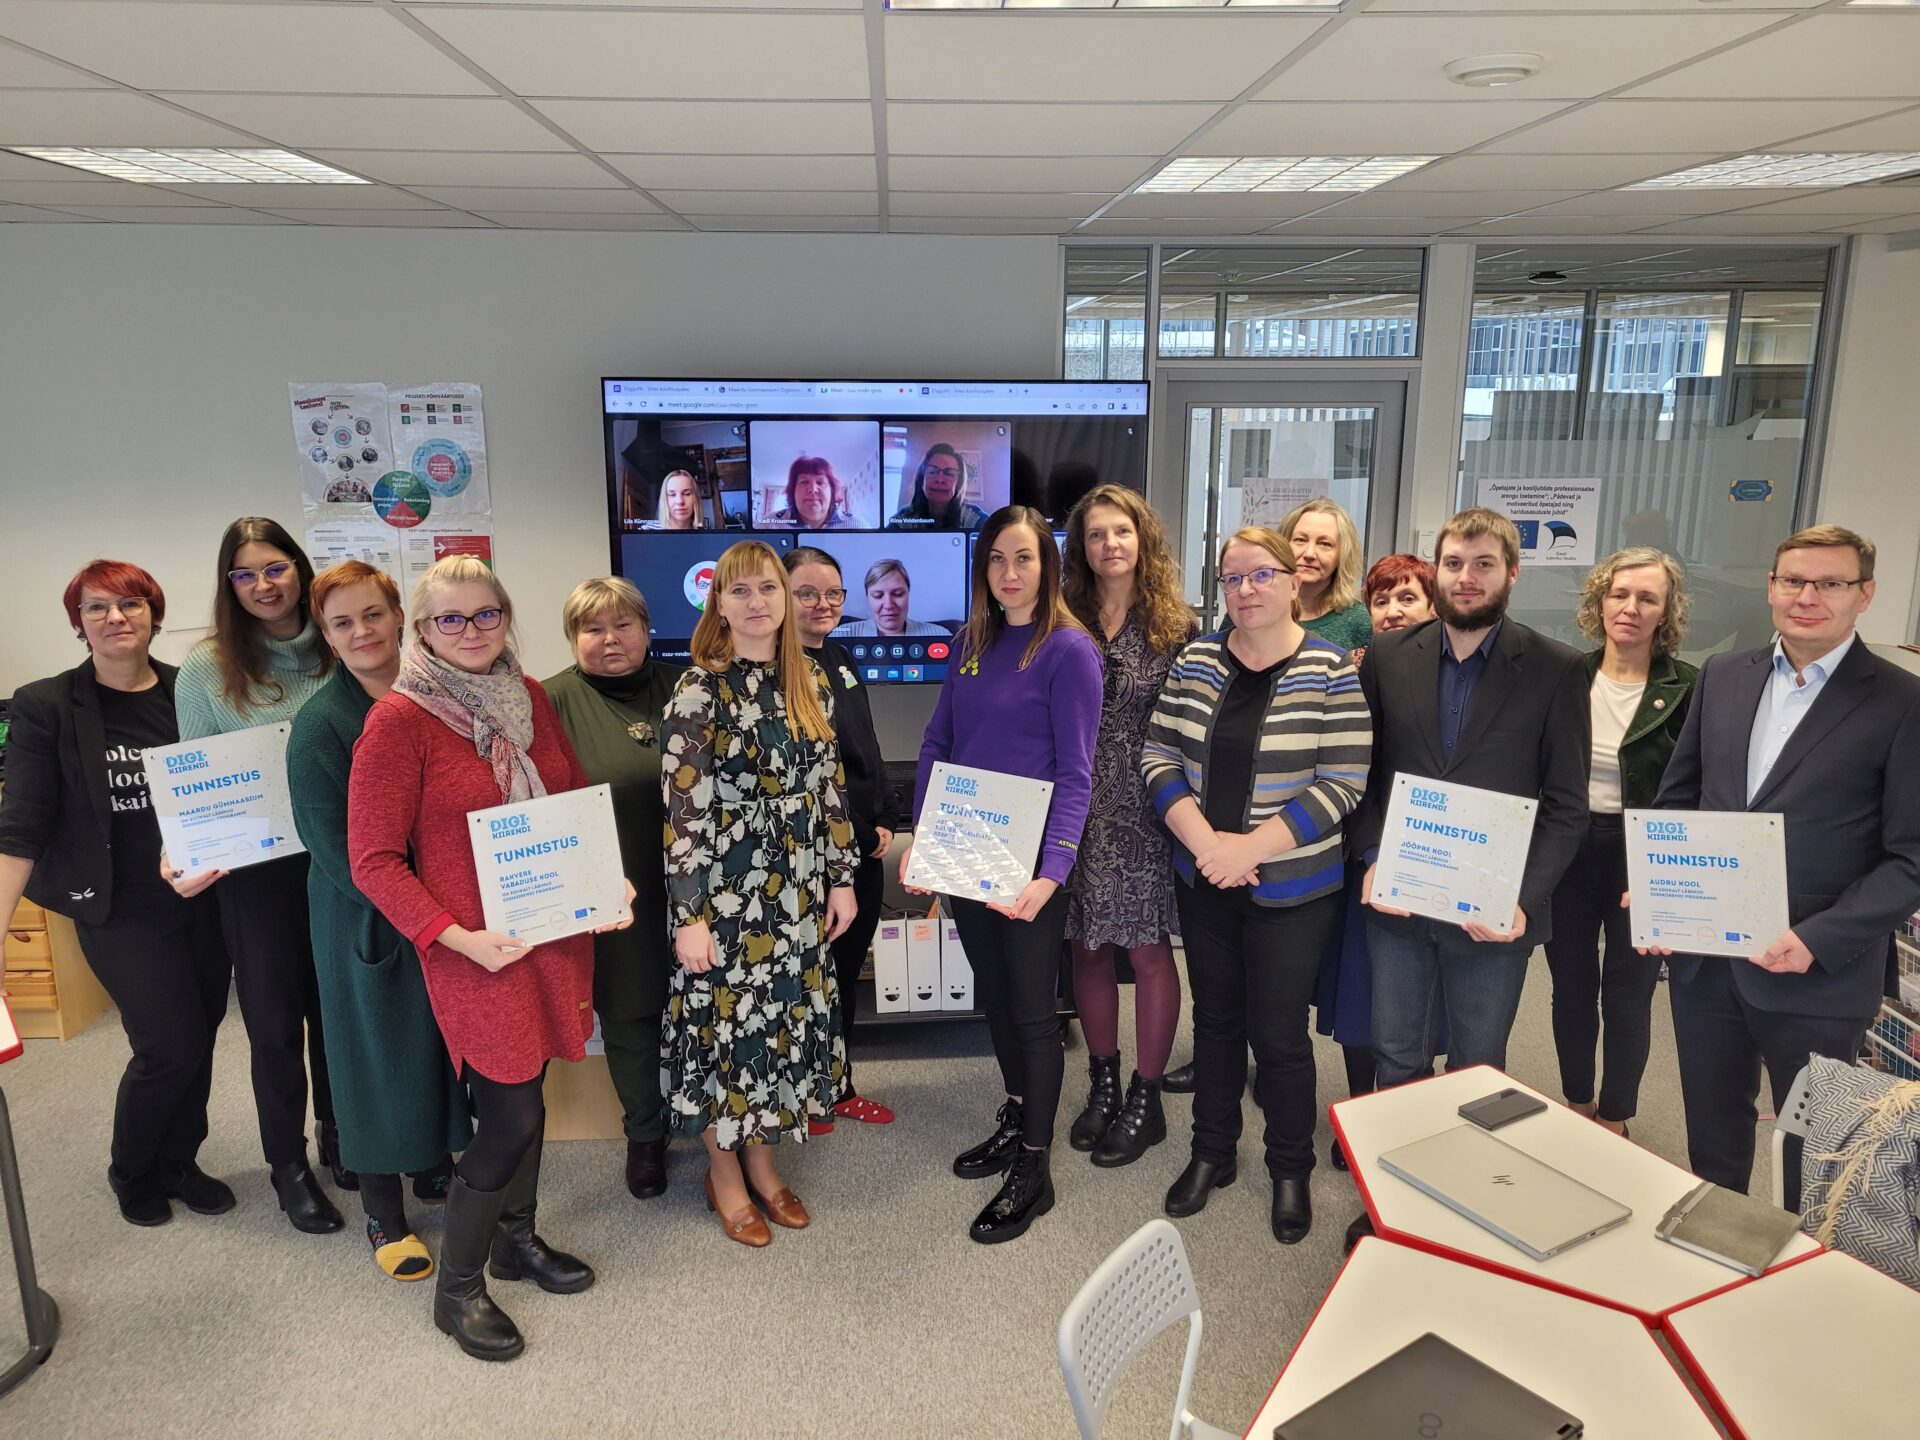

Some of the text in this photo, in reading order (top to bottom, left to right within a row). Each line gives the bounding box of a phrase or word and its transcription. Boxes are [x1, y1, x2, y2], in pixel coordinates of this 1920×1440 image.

[106, 745, 143, 762] ole
[168, 761, 209, 774] KIIRENDI
[172, 770, 261, 797] TUNNISTUS
[945, 786, 977, 797] KIIRENDI
[110, 790, 153, 811] kai
[179, 793, 264, 816] MAARDU GÜMNAASIUM
[1410, 799, 1447, 812] KIIRENDI
[937, 819, 963, 828] ASTGU
[1405, 817, 1488, 844] TUNNISTUS
[492, 825, 531, 839] KIIRENDI
[1647, 833, 1688, 842] KIIRENDI
[494, 835, 579, 864] TUNNISTUS
[1401, 841, 1452, 858] JÕÕPRE KOOL
[1647, 853, 1739, 869] TUNNISTUS
[500, 870, 532, 882] RAKVERE
[501, 871, 559, 889] VABADUSE KOOL
